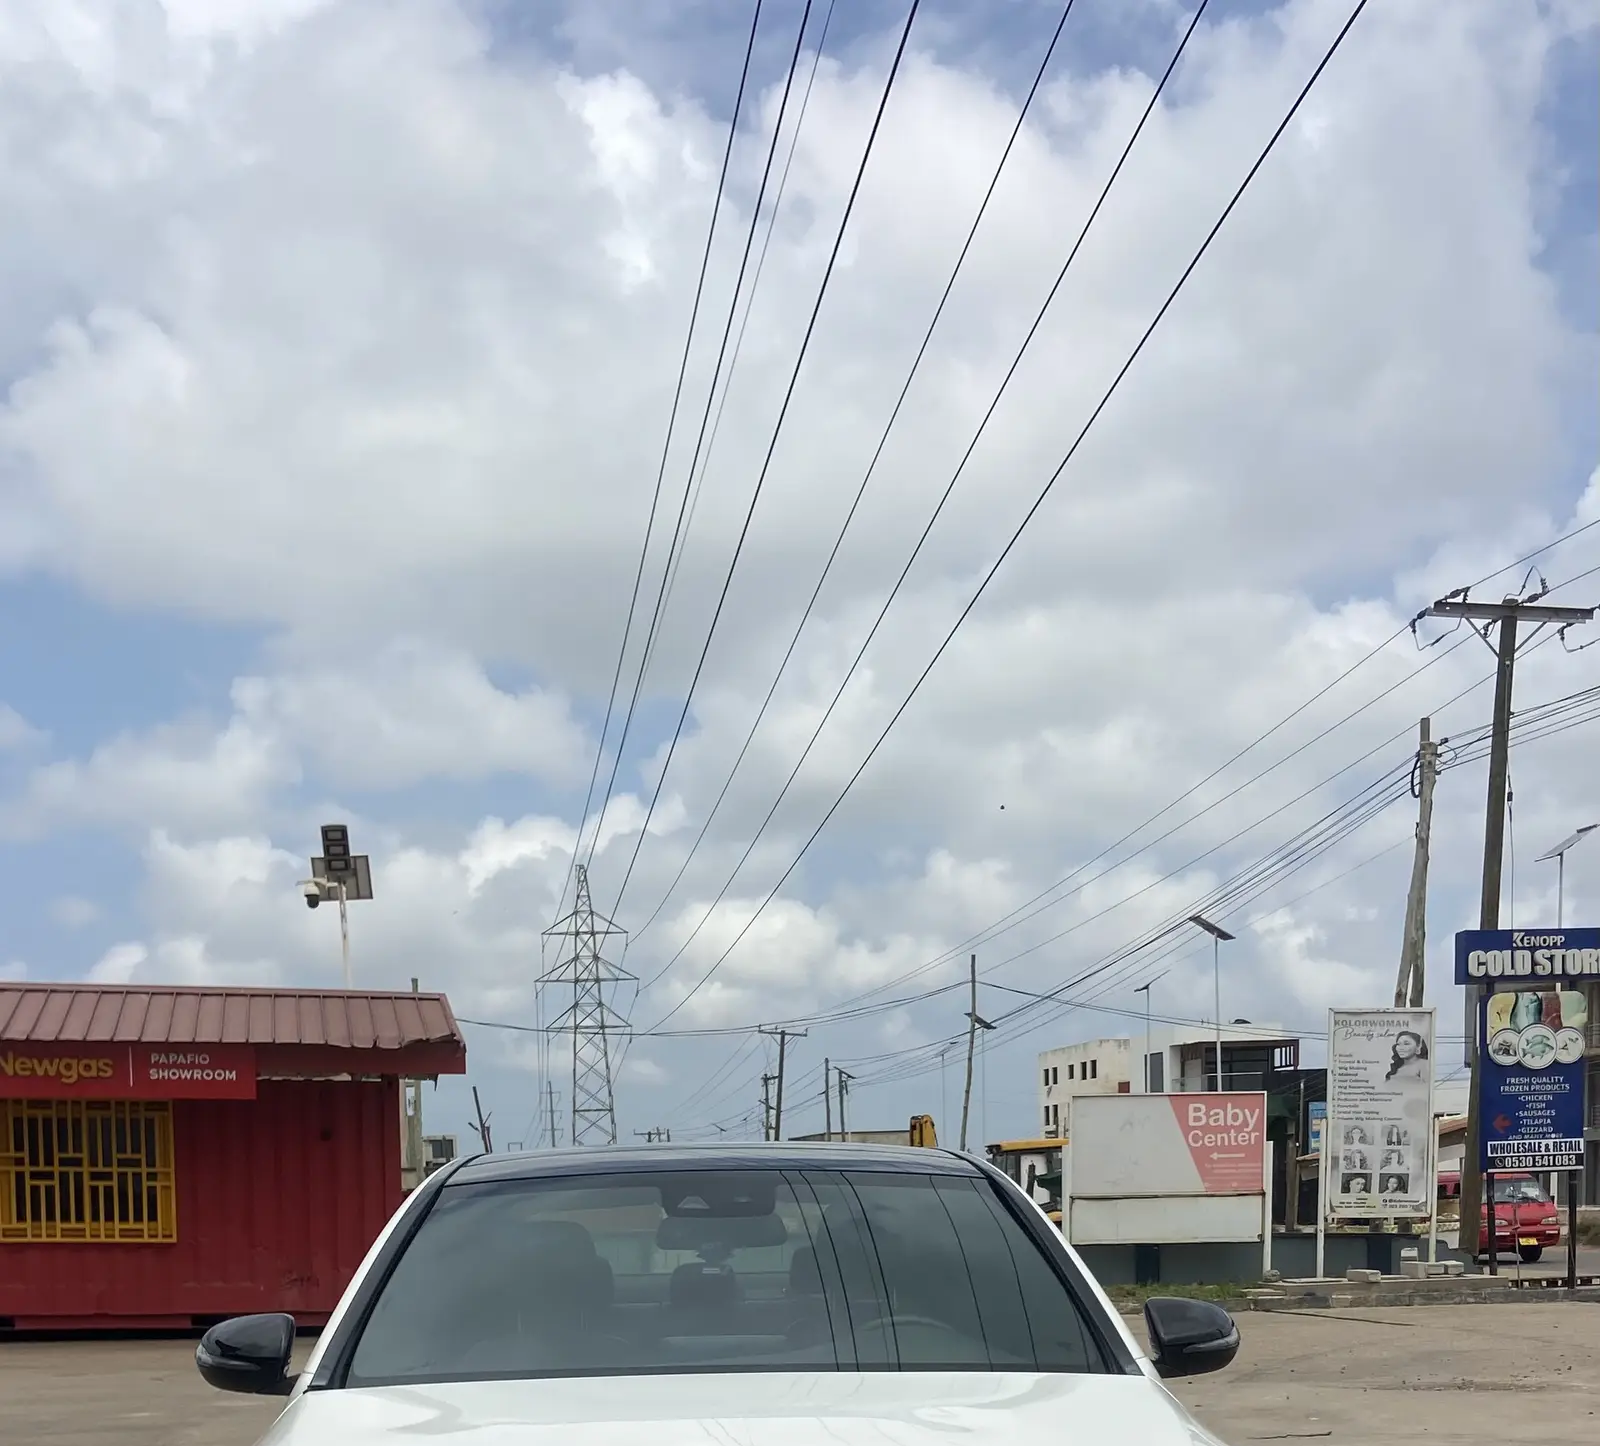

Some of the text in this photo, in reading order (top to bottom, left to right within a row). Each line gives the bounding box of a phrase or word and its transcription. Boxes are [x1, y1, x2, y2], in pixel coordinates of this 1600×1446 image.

[1512, 932, 1565, 947] KENOPP
[1468, 948, 1600, 977] COLD STOR
[151, 1053, 210, 1065] PAPAFIO
[0, 1051, 113, 1084] Newgas
[149, 1067, 237, 1081] SHOWROOM
[1531, 1076, 1564, 1084] QUALITY
[1531, 1083, 1570, 1092] PRODUCTS
[1521, 1094, 1553, 1102] CHICKEN
[1188, 1102, 1260, 1132] Baby
[1518, 1109, 1556, 1117] SAUSAGES
[1188, 1129, 1260, 1147] Center
[1489, 1140, 1582, 1155] WHOLESALE & RETAIL
[1505, 1157, 1533, 1168] 0530
